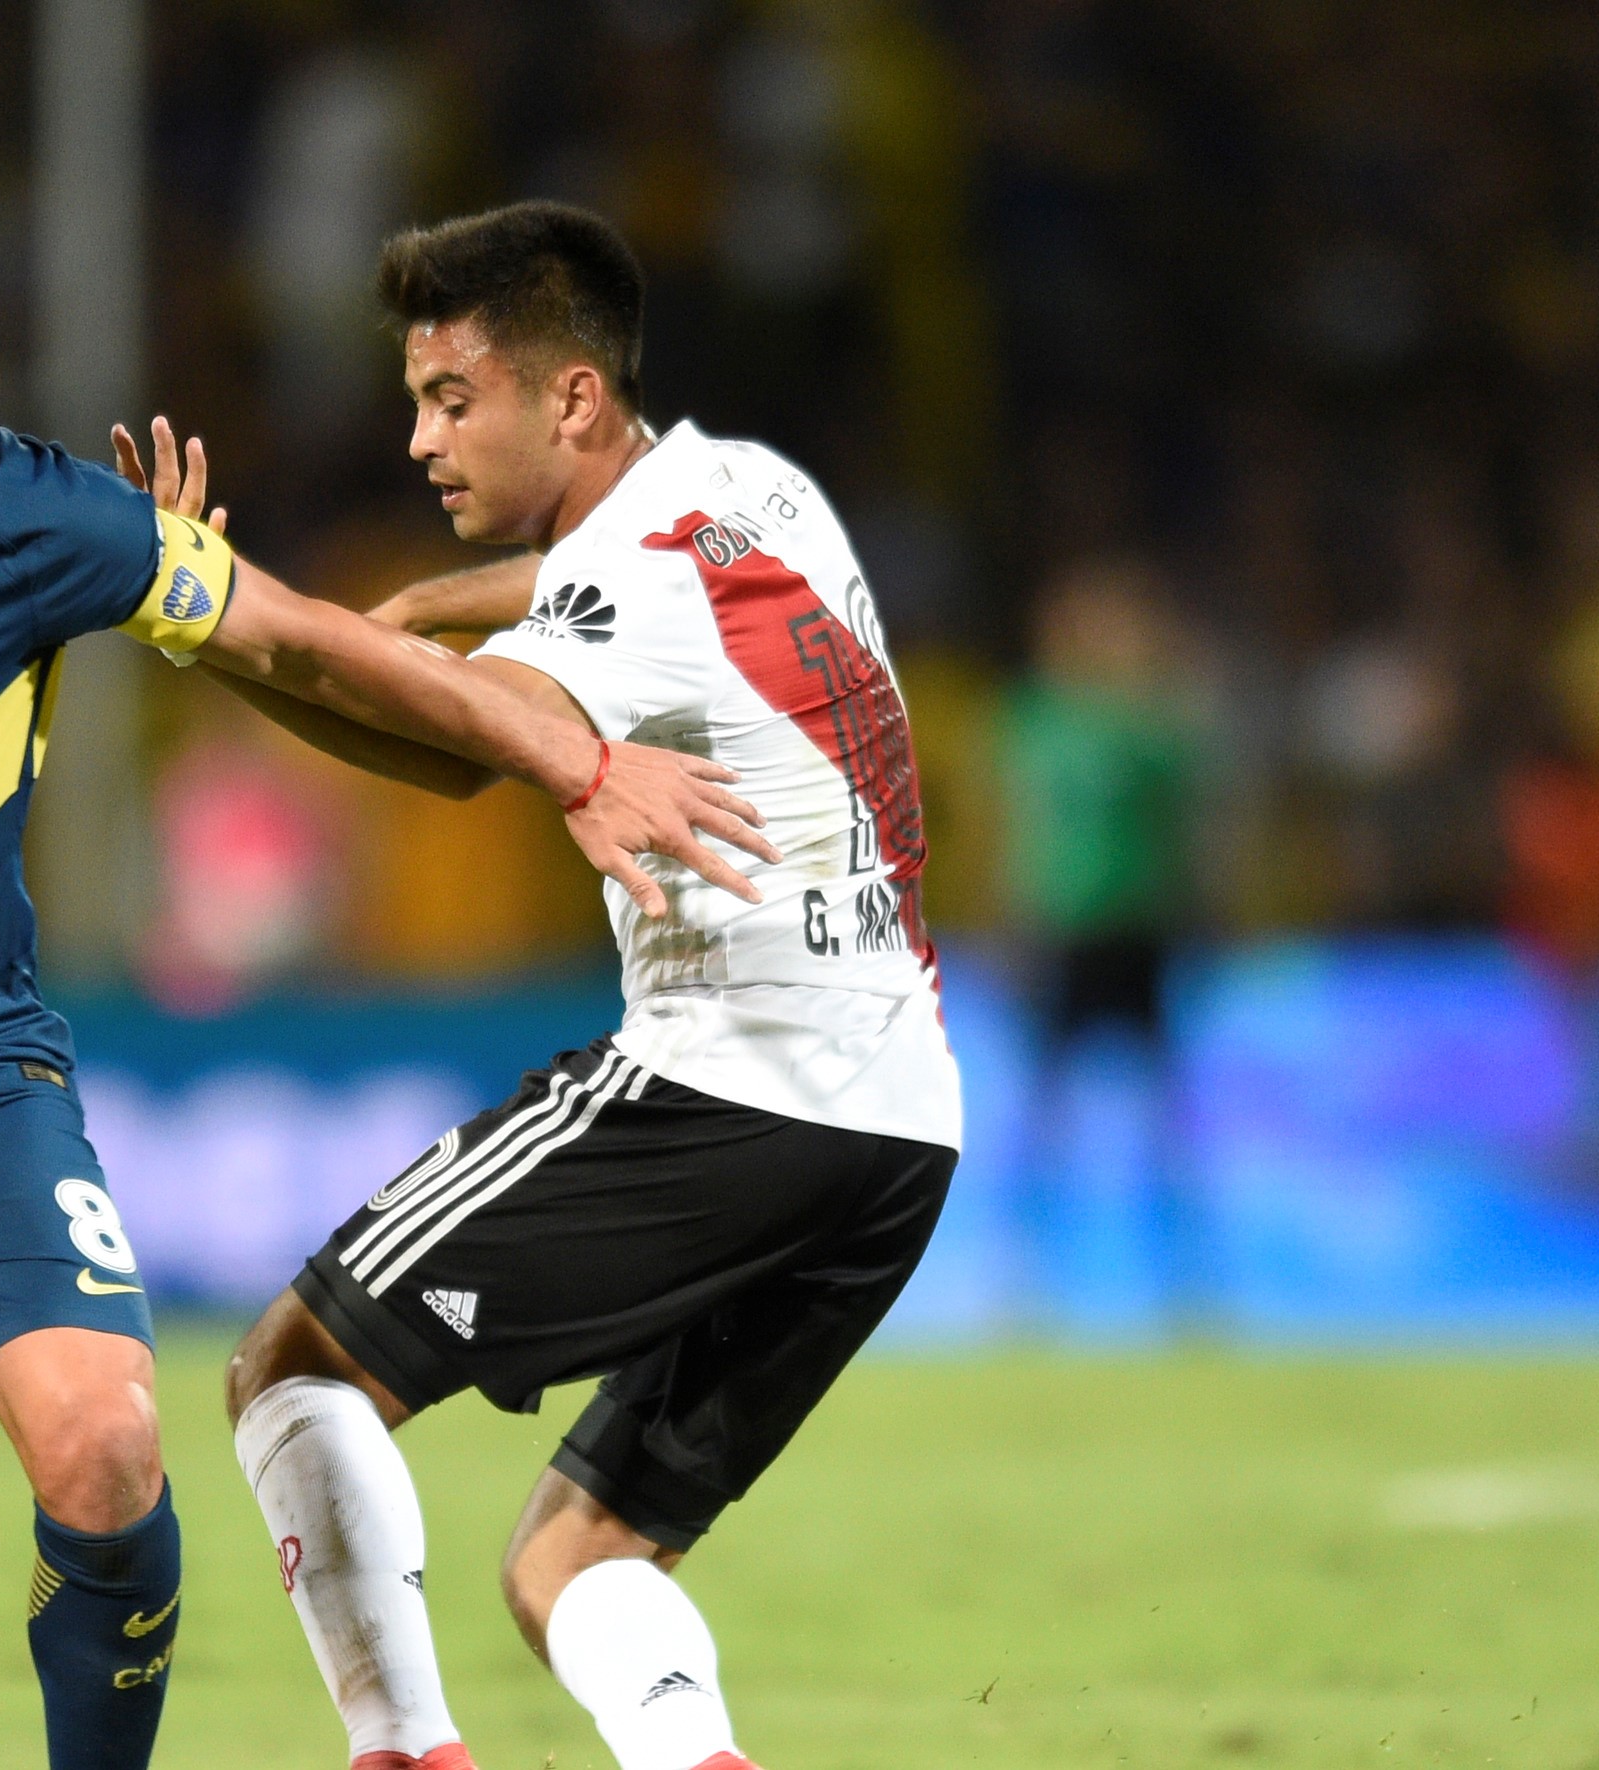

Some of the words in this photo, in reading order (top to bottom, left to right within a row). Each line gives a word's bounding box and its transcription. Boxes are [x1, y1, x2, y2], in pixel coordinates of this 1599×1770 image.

[802, 889, 840, 957] G.
[55, 1178, 138, 1274] 8
[421, 1290, 476, 1341] adidas
